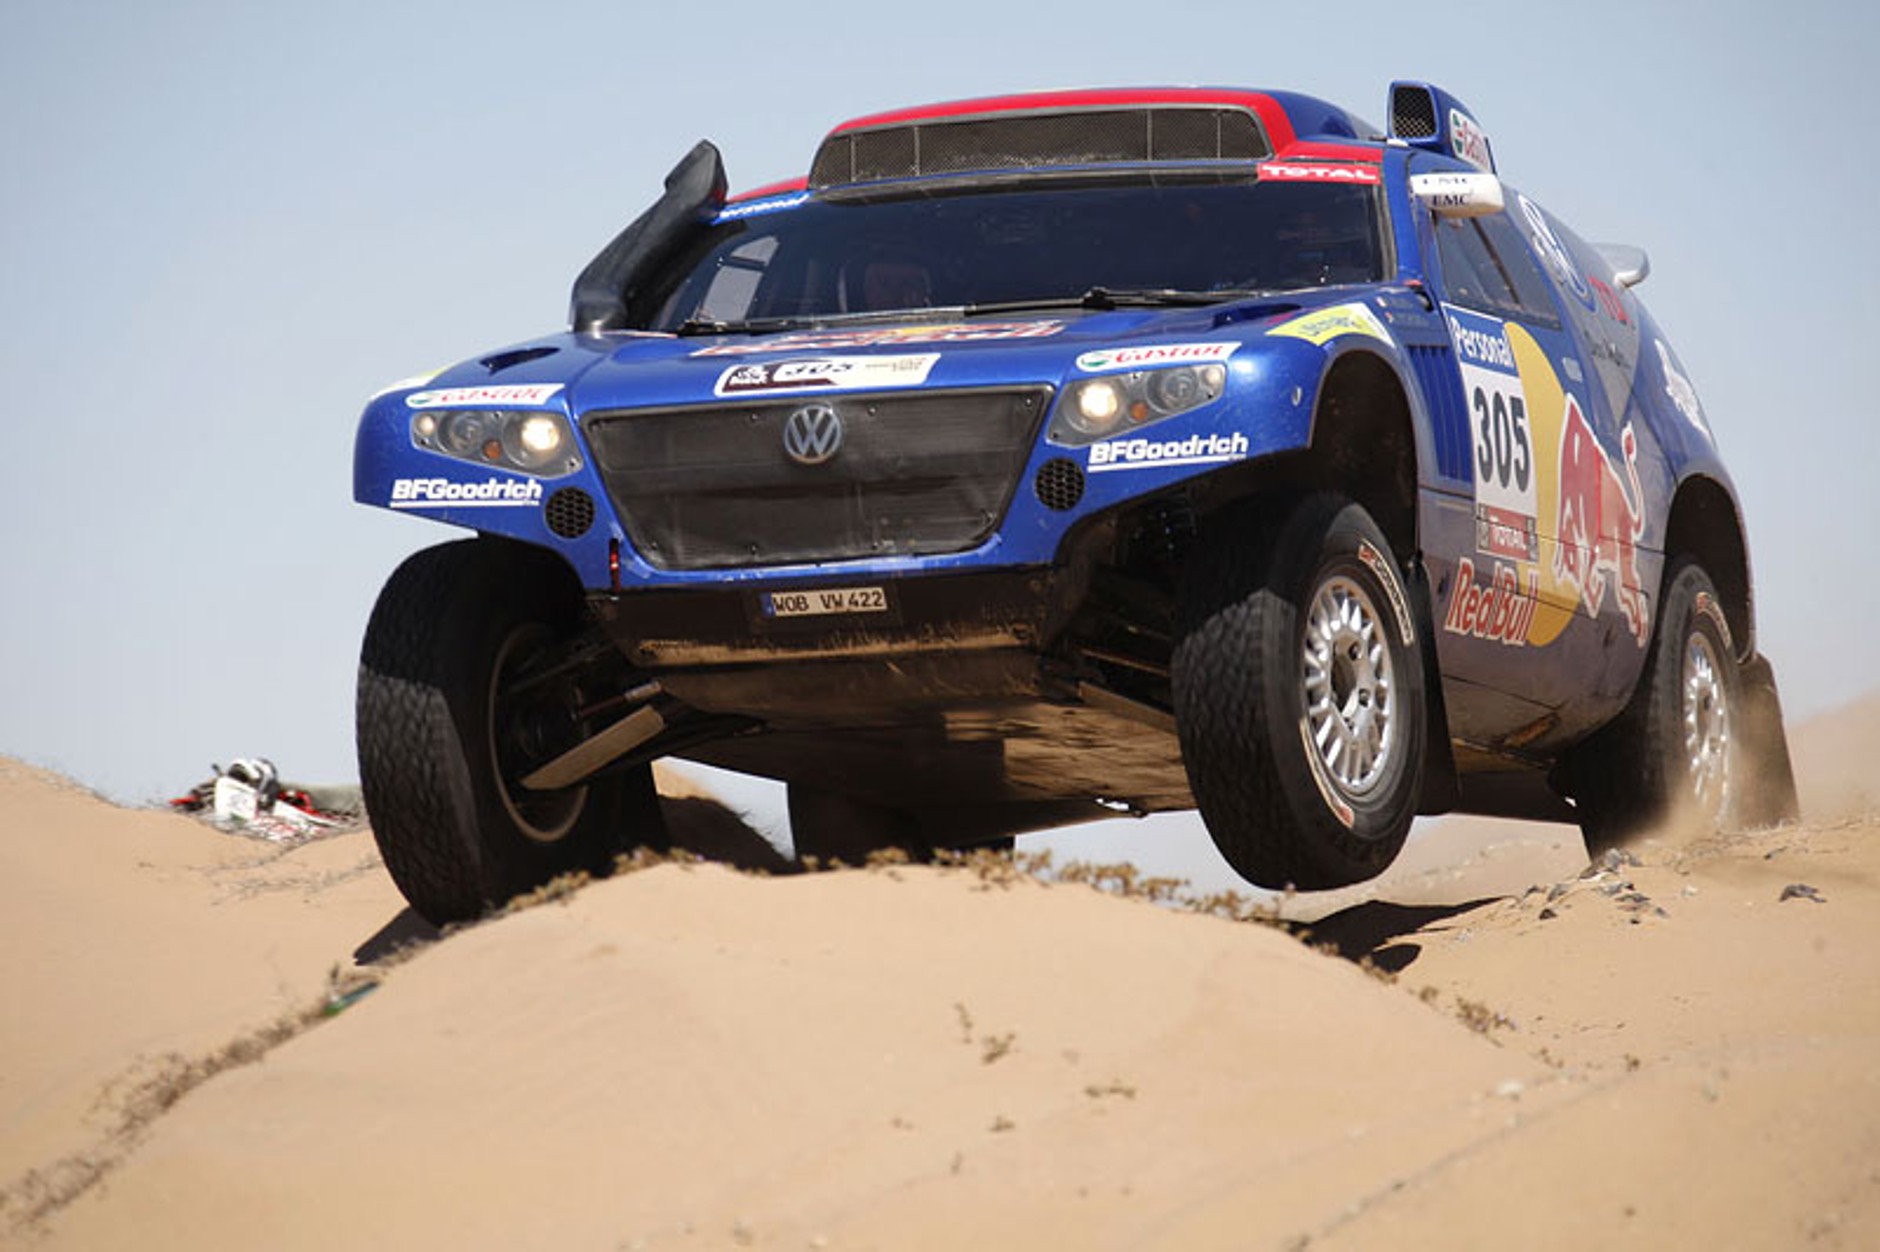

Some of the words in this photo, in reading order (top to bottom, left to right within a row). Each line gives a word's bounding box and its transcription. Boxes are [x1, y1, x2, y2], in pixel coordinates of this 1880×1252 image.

[1262, 164, 1377, 180] TOTAL
[1115, 345, 1224, 363] Castrol
[1449, 315, 1514, 368] Personal
[1088, 431, 1249, 464] BFGoodrich
[1474, 386, 1530, 492] 305
[391, 478, 543, 499] BFGoodrich
[773, 594, 809, 612] WOB
[820, 593, 843, 609] VW
[848, 590, 883, 608] 422
[1444, 556, 1504, 638] Red
[1486, 566, 1539, 646] Bull
